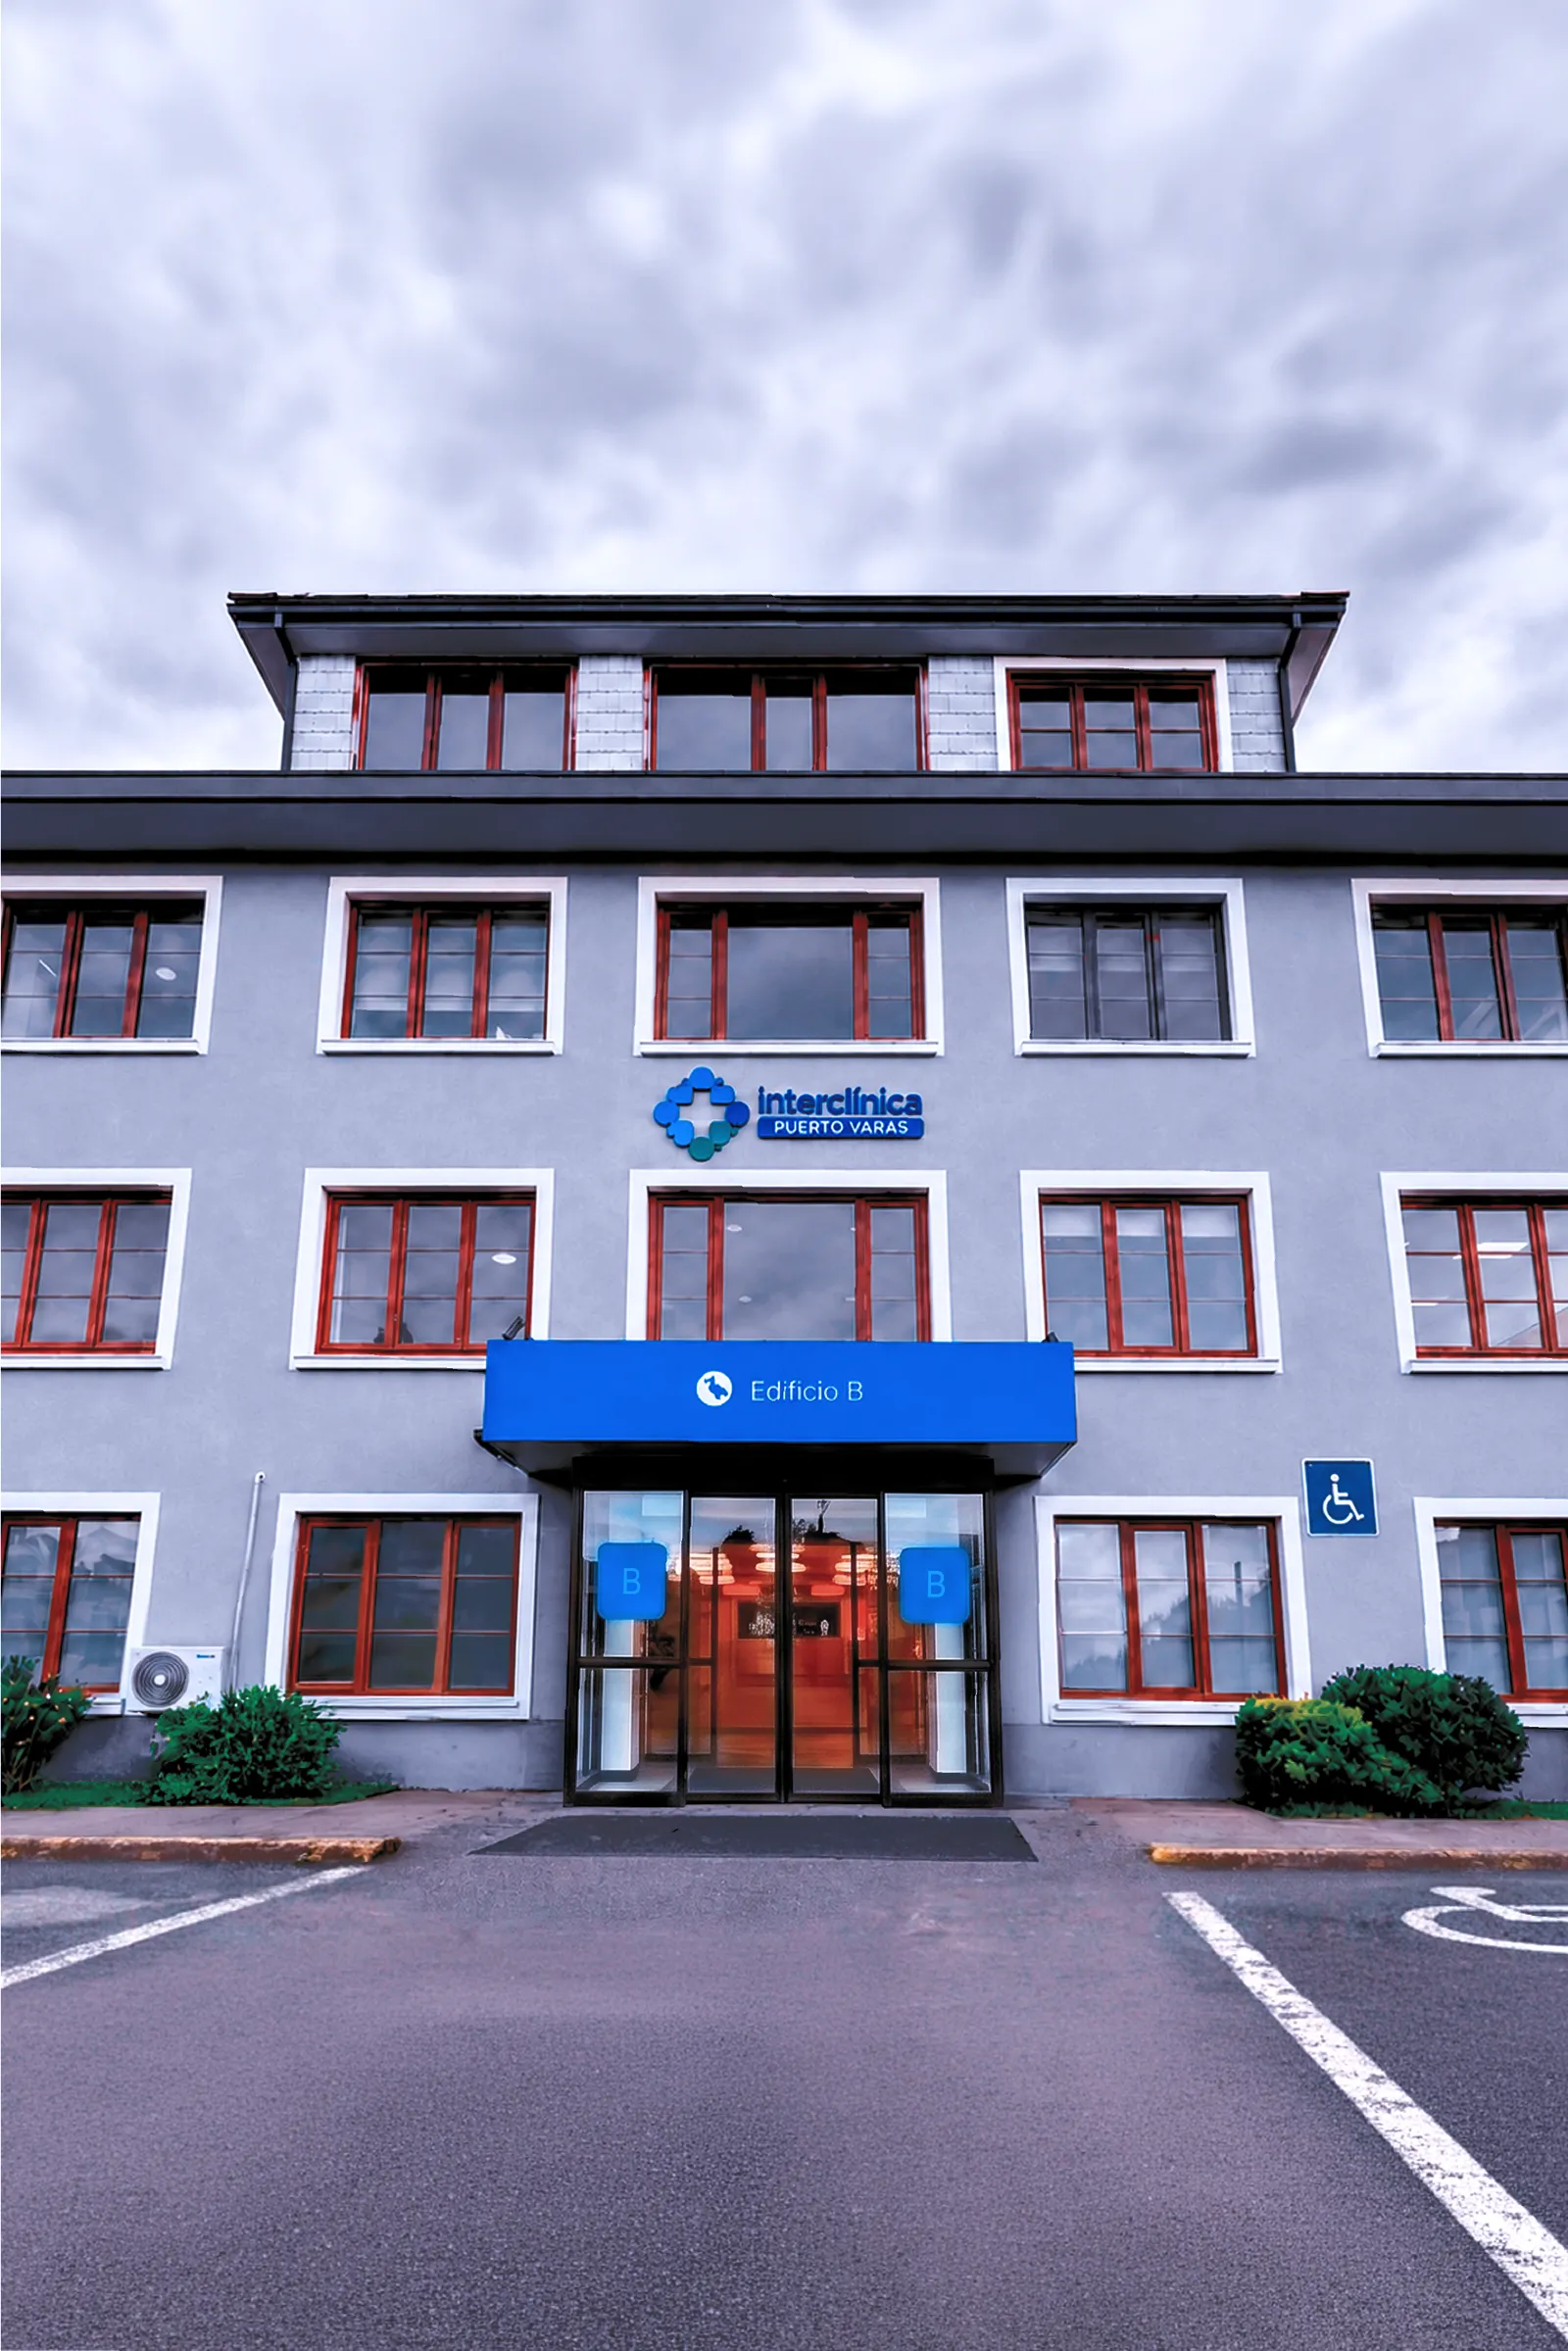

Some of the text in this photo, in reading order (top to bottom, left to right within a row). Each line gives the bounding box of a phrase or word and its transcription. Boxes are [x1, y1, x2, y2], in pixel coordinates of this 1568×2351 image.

[758, 1086, 922, 1115] interclínica
[774, 1120, 908, 1134] PUERTO VARAS
[751, 1380, 863, 1401] Edificio B
[622, 1568, 641, 1594] B
[927, 1571, 946, 1597] B
